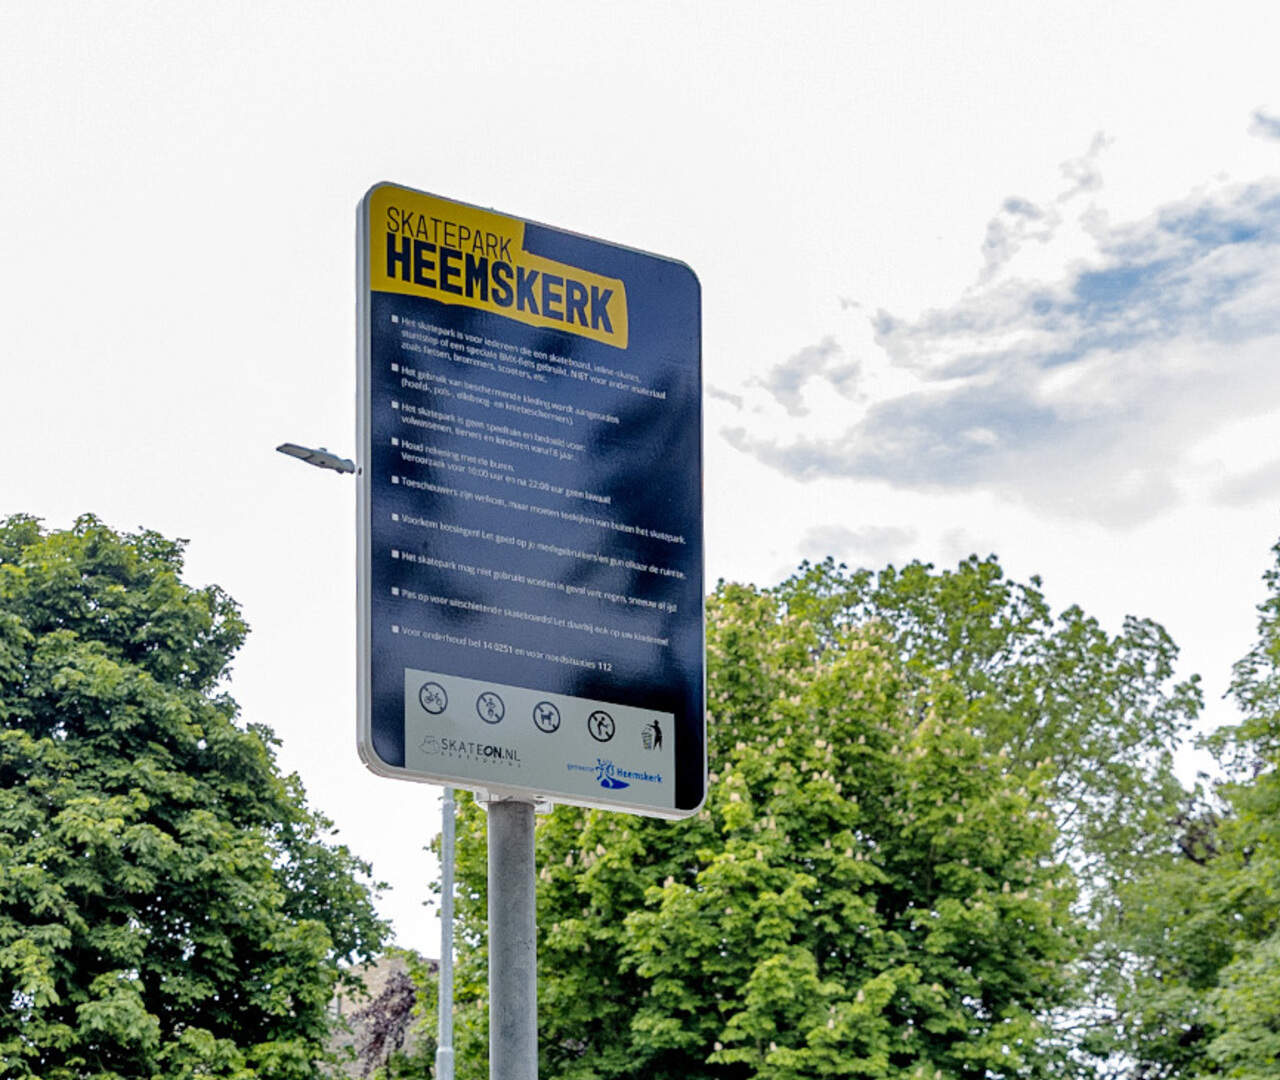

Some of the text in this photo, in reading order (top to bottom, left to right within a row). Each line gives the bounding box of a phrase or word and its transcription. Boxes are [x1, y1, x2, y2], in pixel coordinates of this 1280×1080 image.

[387, 206, 513, 264] SKATEPARK
[386, 231, 614, 334] HEEMSKERK
[401, 341, 422, 353] zoals
[423, 346, 452, 361] fietsen,
[453, 353, 496, 372] brommers,
[402, 317, 415, 328] Het
[418, 321, 455, 340] skatepark
[457, 330, 463, 340] is
[465, 334, 483, 345] voor
[484, 337, 518, 353] iedereen
[520, 346, 532, 356] die
[534, 351, 547, 360] een
[402, 366, 415, 377] Het
[418, 370, 447, 386] gebruik
[449, 379, 461, 388] van
[464, 381, 521, 401] beschermende
[523, 394, 551, 410] kleding
[552, 401, 573, 413] wordt
[441, 339, 448, 348] of
[450, 343, 465, 352] een
[466, 345, 498, 361] speciale
[571, 370, 588, 381] NIET
[590, 376, 607, 386] voor
[632, 385, 666, 400] materiaal
[402, 403, 415, 414] Het
[418, 407, 456, 425] skatepark
[458, 416, 464, 425] is
[465, 420, 485, 431] geen
[487, 423, 521, 439] speeltuin
[535, 433, 565, 447] bedoeld
[494, 401, 504, 409] en
[402, 439, 424, 452] Houd
[425, 445, 460, 461] rekening
[461, 452, 476, 464] met
[478, 456, 488, 466] de
[455, 427, 481, 440] tieners
[484, 435, 494, 443] en
[496, 436, 530, 451] kinderen
[402, 452, 445, 469] Veroorzaak
[447, 463, 466, 473] voor
[490, 473, 504, 481] uur
[505, 476, 515, 484] en
[517, 478, 526, 486] na
[551, 486, 564, 494] uur
[565, 489, 584, 500] geen
[402, 477, 457, 496] Toeschouwers
[459, 489, 473, 501] zijn
[509, 501, 528, 511] maar
[530, 504, 559, 518] moeten
[561, 510, 595, 527] toekijken
[596, 520, 609, 528] van
[611, 521, 634, 533] buiten
[636, 526, 648, 536] het
[402, 514, 438, 529] Voorkom
[482, 530, 494, 541] Let
[496, 533, 515, 546] goed
[516, 539, 526, 549] op
[528, 540, 535, 551] je
[537, 542, 597, 563] medegebruikers
[610, 558, 624, 569] gun
[625, 560, 648, 572] elkaar
[649, 565, 658, 574] de
[402, 551, 416, 562] Het
[419, 554, 456, 572] skatepark
[458, 564, 475, 575] mag
[477, 566, 492, 577] niet
[493, 569, 525, 585] gebruikt
[527, 576, 556, 589] worden
[557, 582, 564, 591] in
[566, 583, 586, 597] geval
[629, 598, 656, 609] sneeuw
[658, 601, 666, 611] of
[402, 588, 417, 599] Pas
[418, 594, 429, 603] op
[430, 596, 448, 605] voor
[554, 617, 566, 627] Let
[568, 620, 593, 634] daarbij
[595, 625, 607, 635] ook
[610, 630, 620, 639] op
[622, 632, 632, 640] uw
[402, 625, 612, 672] Voor onderhoud bel 14 0251 en voor noodsituaties 112
[441, 737, 520, 762] SKATEON.NL
[617, 767, 662, 783] Heemskerk
